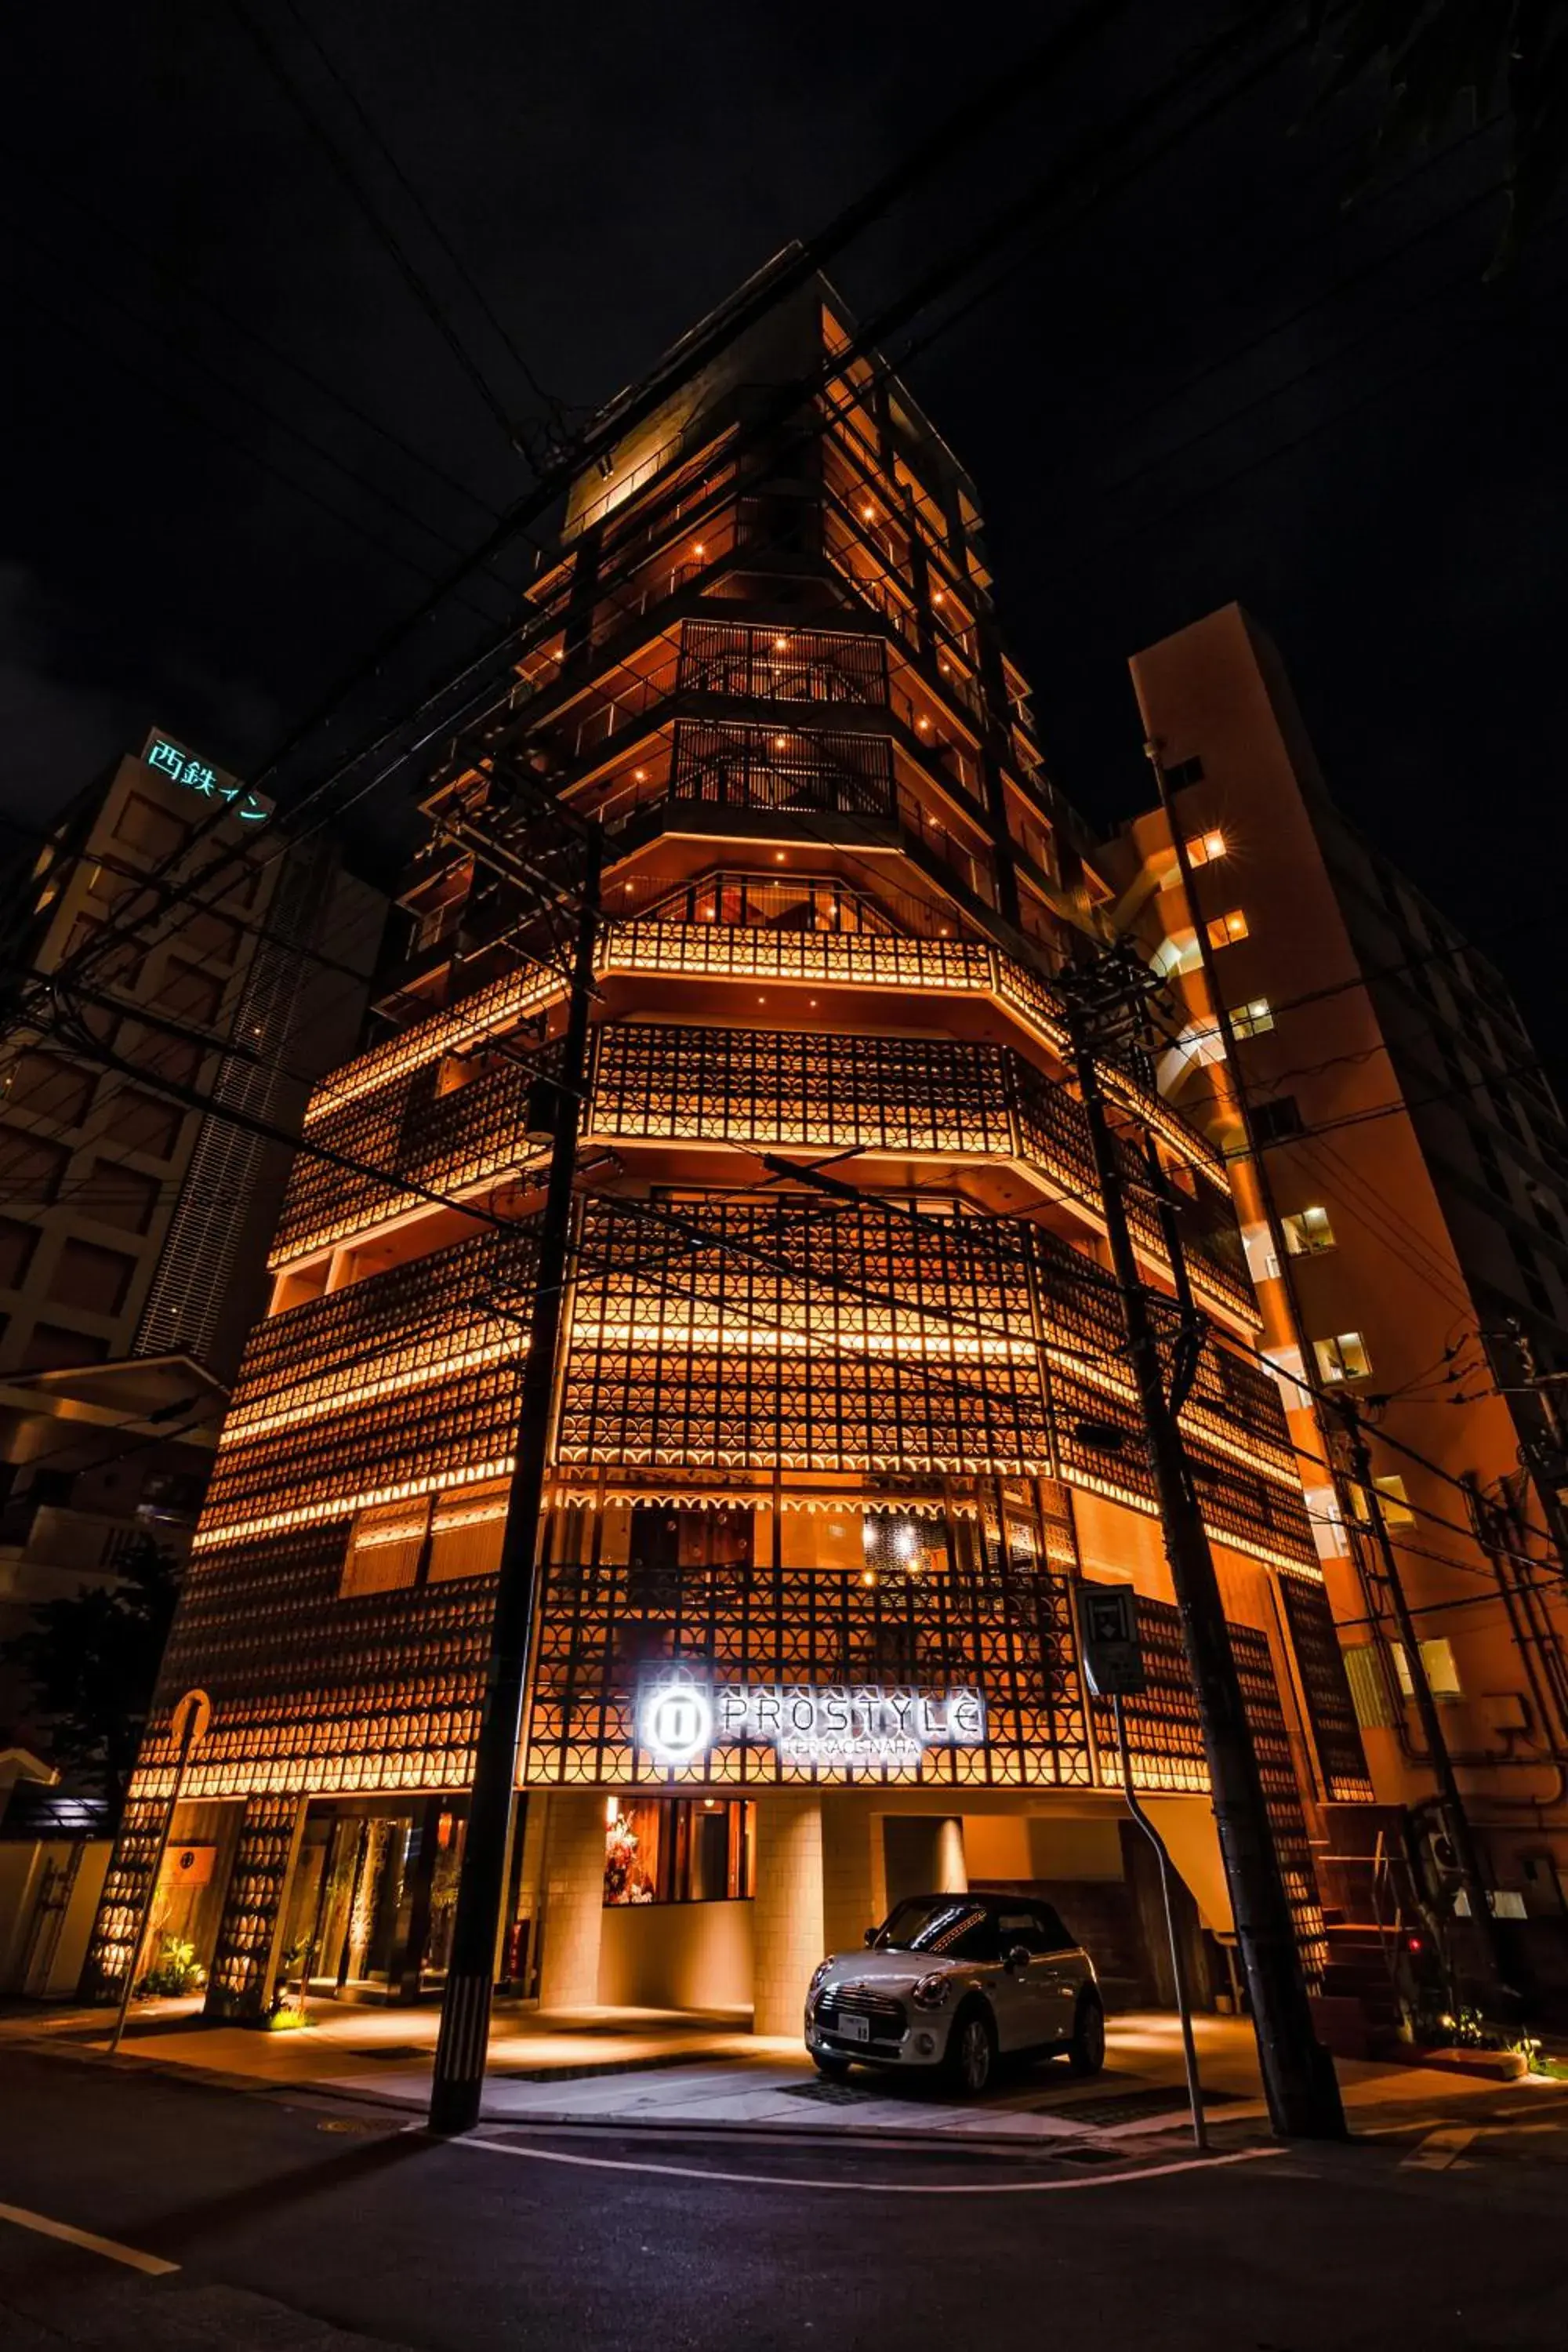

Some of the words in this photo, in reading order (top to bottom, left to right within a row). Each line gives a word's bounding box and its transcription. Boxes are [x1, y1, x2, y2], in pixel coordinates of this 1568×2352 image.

[148, 739, 267, 818] 西鉄イン
[722, 1698, 978, 1732] PROSTYLE
[784, 1739, 862, 1755] TERRACE
[869, 1739, 919, 1755] NAHA
